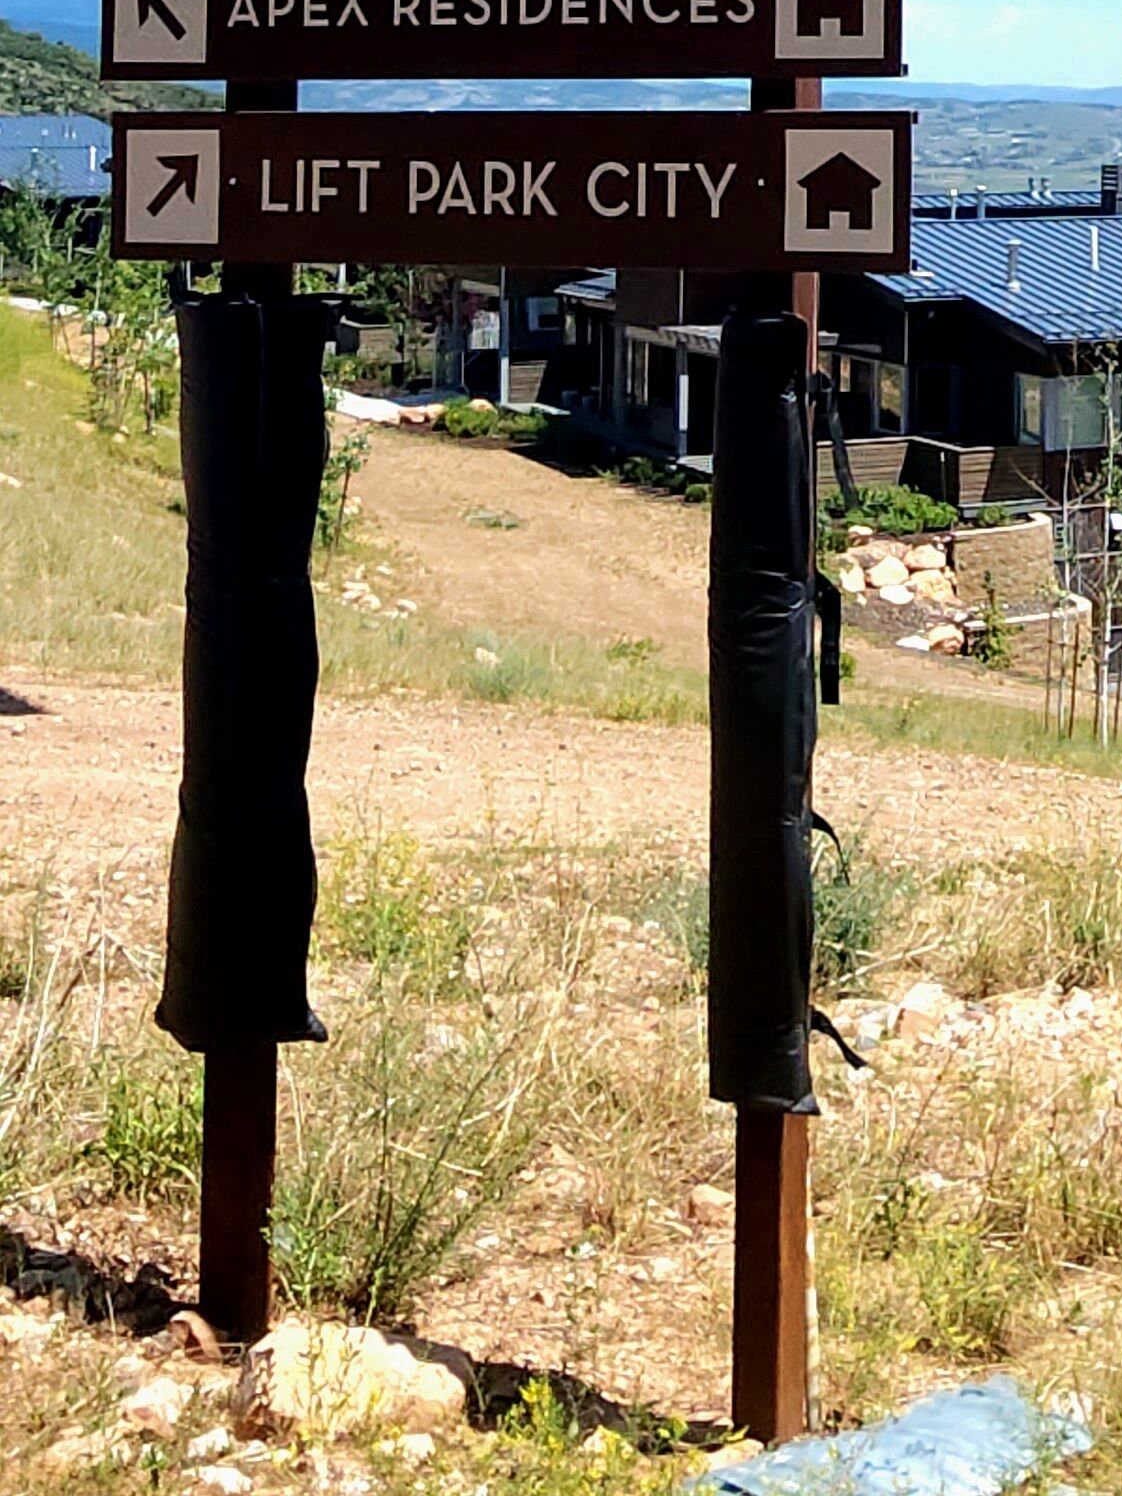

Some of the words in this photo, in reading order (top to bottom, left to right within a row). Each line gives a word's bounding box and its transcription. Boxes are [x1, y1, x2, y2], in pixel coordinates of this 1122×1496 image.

[261, 158, 381, 213] LIFT
[408, 160, 558, 216] PARK
[587, 161, 737, 219] CITY
